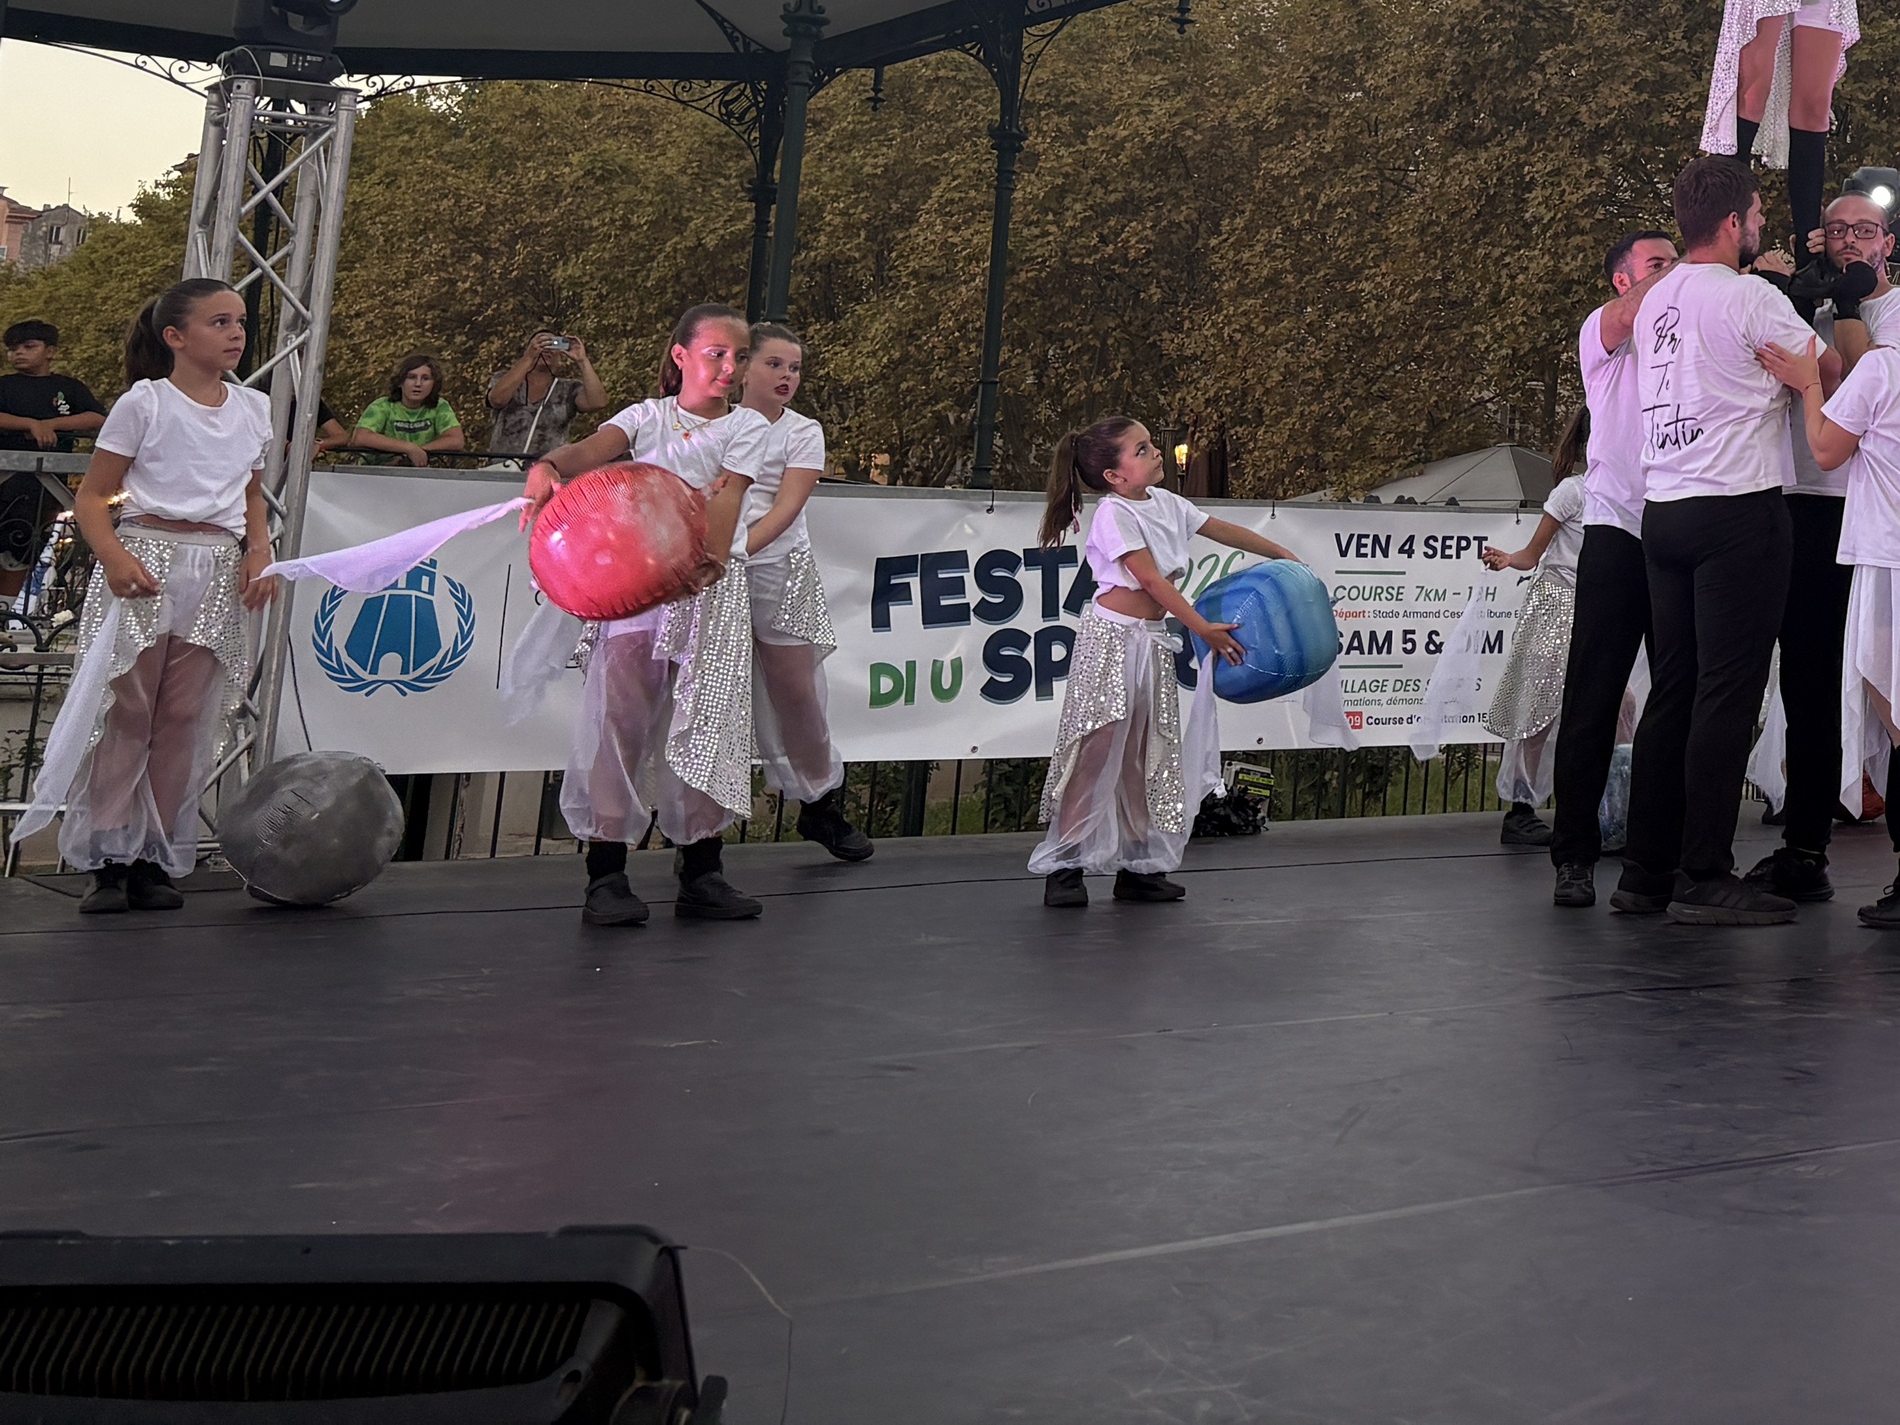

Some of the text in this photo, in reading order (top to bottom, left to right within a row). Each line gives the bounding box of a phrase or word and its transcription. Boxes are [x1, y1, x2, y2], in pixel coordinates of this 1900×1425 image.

[1334, 533, 1489, 560] VEN 4 SEPT
[1333, 585, 1405, 602] COURSE
[1372, 608, 1400, 620] Stade
[1402, 608, 1441, 620] Armand
[1402, 629, 1417, 655] 5
[1424, 629, 1445, 655] &
[869, 660, 917, 709] DI
[930, 656, 963, 703] U
[1341, 679, 1389, 693] ILLAGE
[1392, 679, 1421, 693] DES
[1366, 715, 1404, 726] Course
